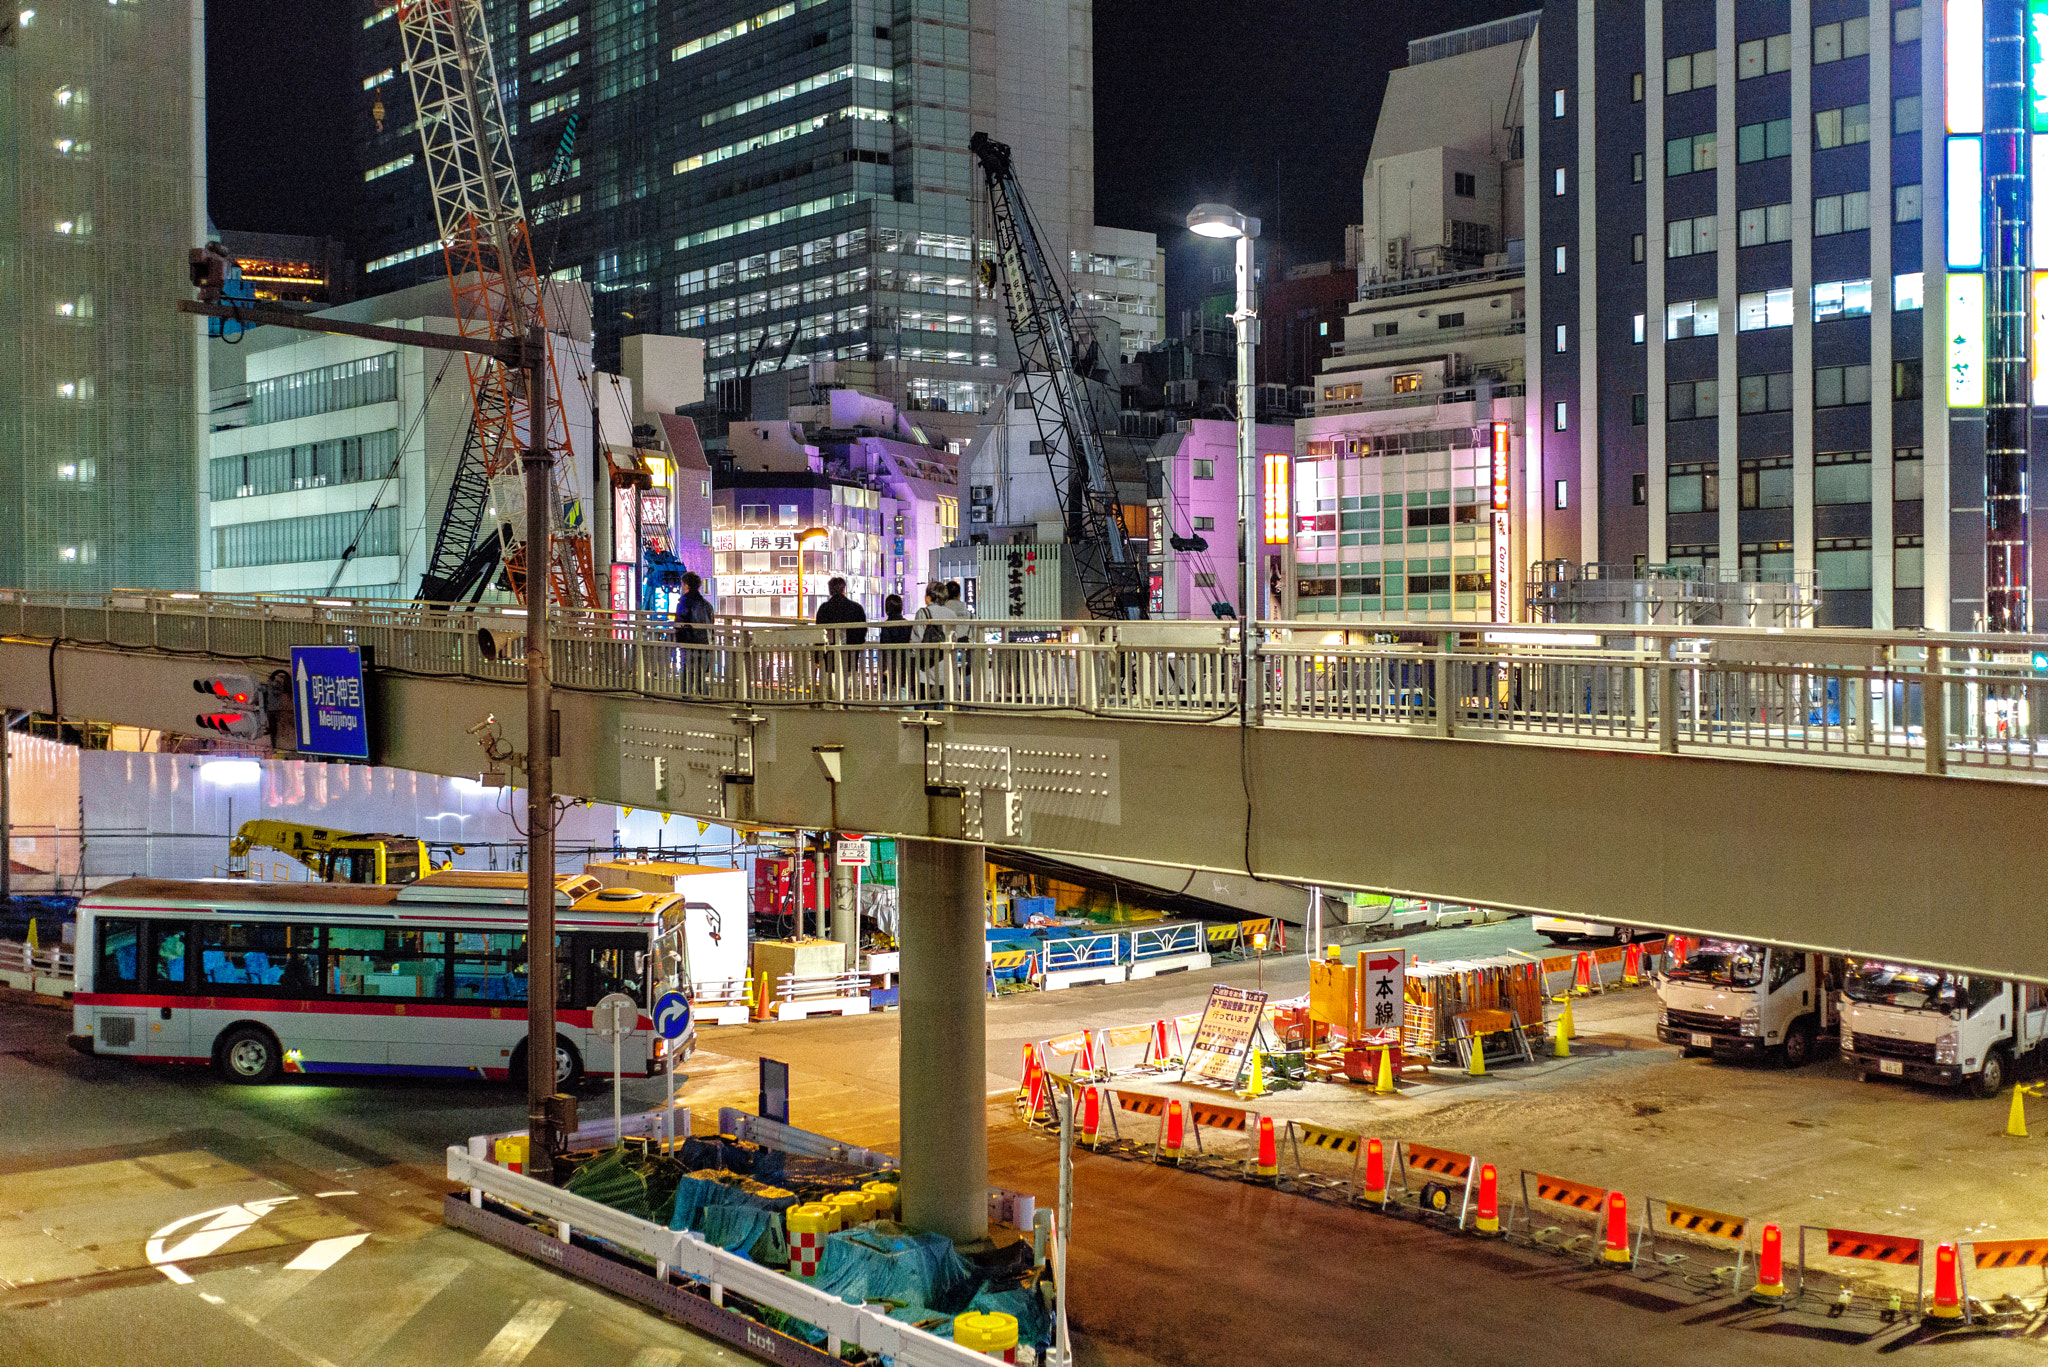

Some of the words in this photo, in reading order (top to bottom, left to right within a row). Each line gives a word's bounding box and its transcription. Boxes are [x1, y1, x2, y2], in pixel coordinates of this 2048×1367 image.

[311, 675, 361, 708] 明治神宮
[319, 710, 358, 731] Meijijingu
[1375, 975, 1394, 1026] 本線
[1212, 1010, 1251, 1024] 行っています
